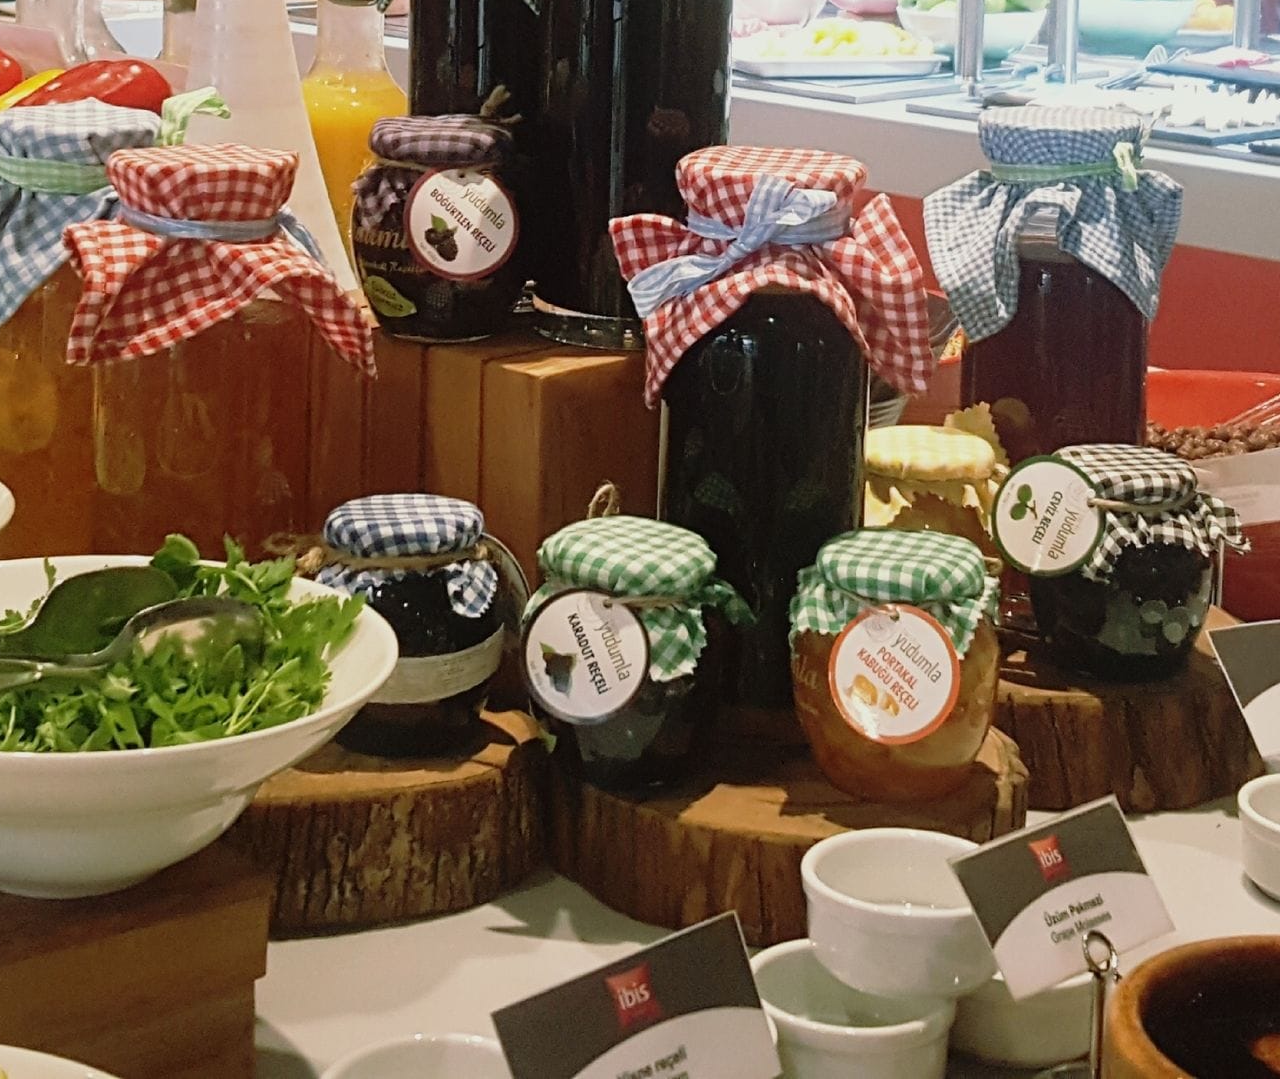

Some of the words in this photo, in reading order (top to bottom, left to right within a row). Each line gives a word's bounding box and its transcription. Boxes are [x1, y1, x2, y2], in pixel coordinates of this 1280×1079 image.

[461, 187, 506, 231] yudumla
[1047, 507, 1079, 560] yudumla
[567, 613, 595, 661] KARADUT
[593, 621, 633, 682] yudumla
[890, 633, 943, 684] yudumla
[876, 646, 919, 690] PORTAKAL
[1039, 846, 1063, 869] ibis
[617, 982, 651, 1011] ibis
